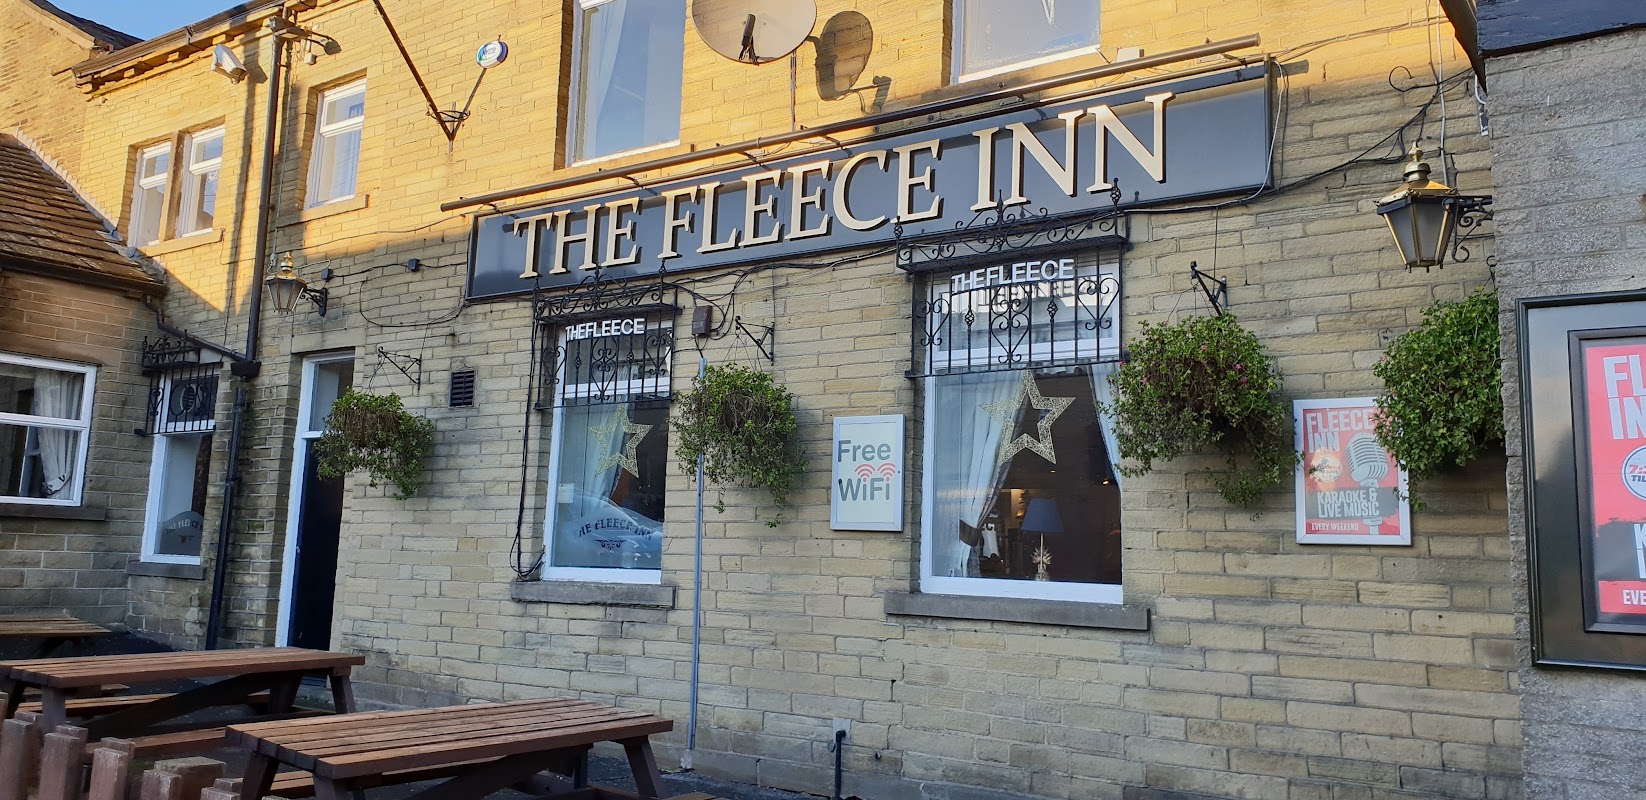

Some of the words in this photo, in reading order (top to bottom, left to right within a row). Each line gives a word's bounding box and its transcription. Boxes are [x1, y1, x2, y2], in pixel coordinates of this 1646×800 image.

[512, 196, 641, 280] THE
[658, 138, 943, 260] FLEECE
[969, 91, 1176, 212] INN
[1306, 409, 1374, 432] FLEECE
[838, 440, 891, 462] Free
[1307, 430, 1341, 453] INN
[838, 473, 890, 501] WiFi
[1317, 490, 1367, 505] KARAOKE
[1369, 487, 1378, 502] &
[1317, 502, 1342, 518] LIVE
[1343, 500, 1380, 517] MUSIC
[1311, 522, 1330, 531] EVERY
[1330, 522, 1359, 531] WEEKEND
